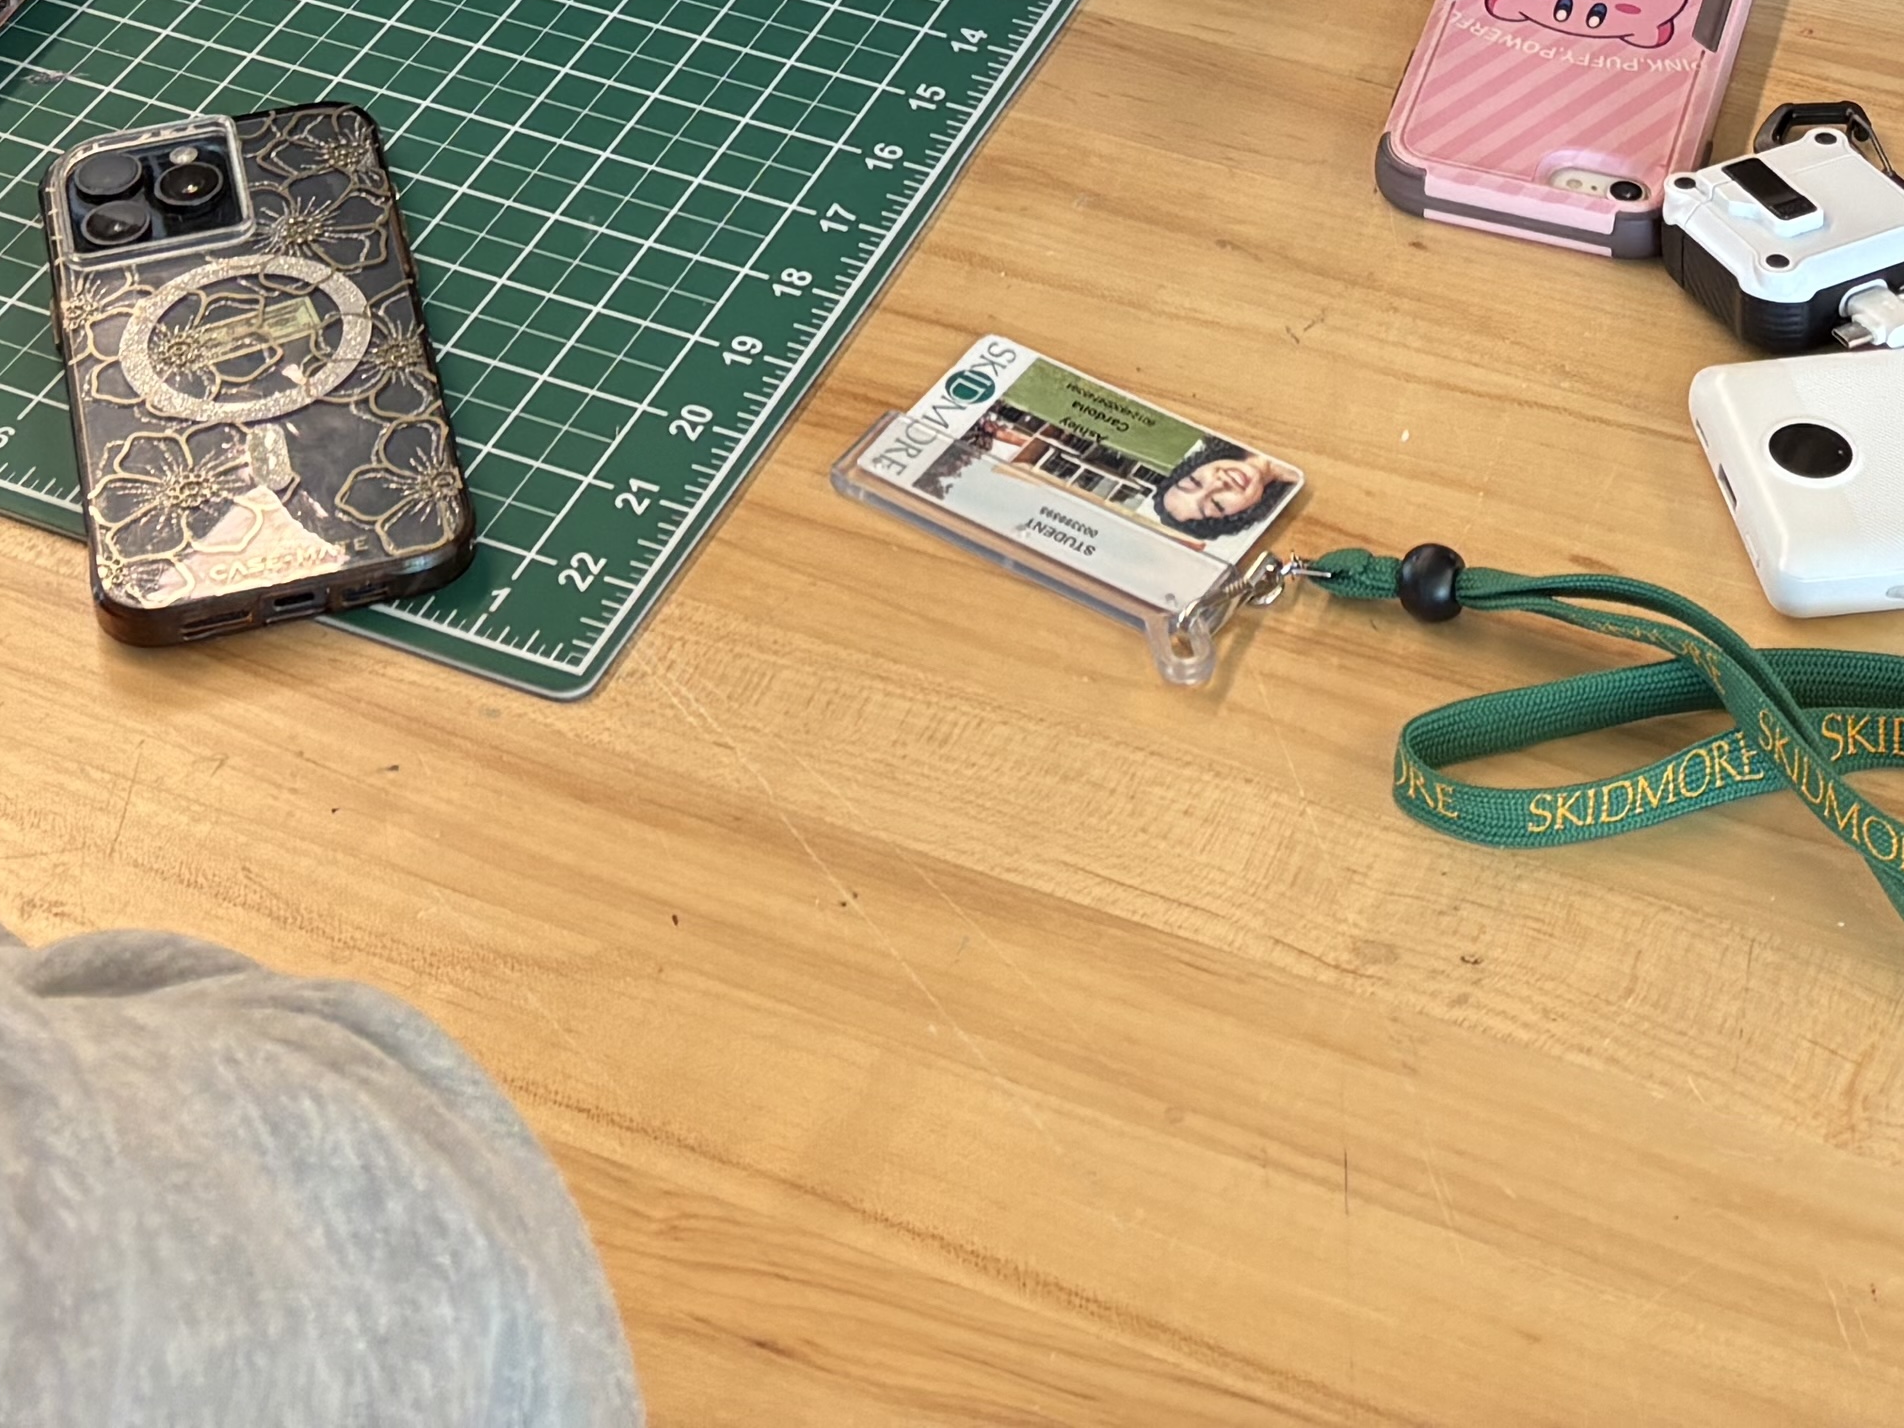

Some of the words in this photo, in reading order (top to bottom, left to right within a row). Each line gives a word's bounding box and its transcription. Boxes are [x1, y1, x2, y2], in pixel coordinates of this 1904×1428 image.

[950, 27, 988, 53] 14
[908, 83, 946, 110] 15
[864, 142, 904, 170] 16
[819, 202, 857, 233] 17
[772, 267, 813, 297] 18
[722, 335, 763, 366] 19
[668, 404, 714, 442] 20
[872, 339, 1018, 477] SKIDMORE
[1071, 399, 1131, 434] Cardona
[614, 478, 660, 516] 21
[1024, 518, 1097, 557] STUDENT
[557, 551, 608, 593] 22
[488, 587, 512, 613] 1
[1527, 730, 1764, 835] SKIDMORE
